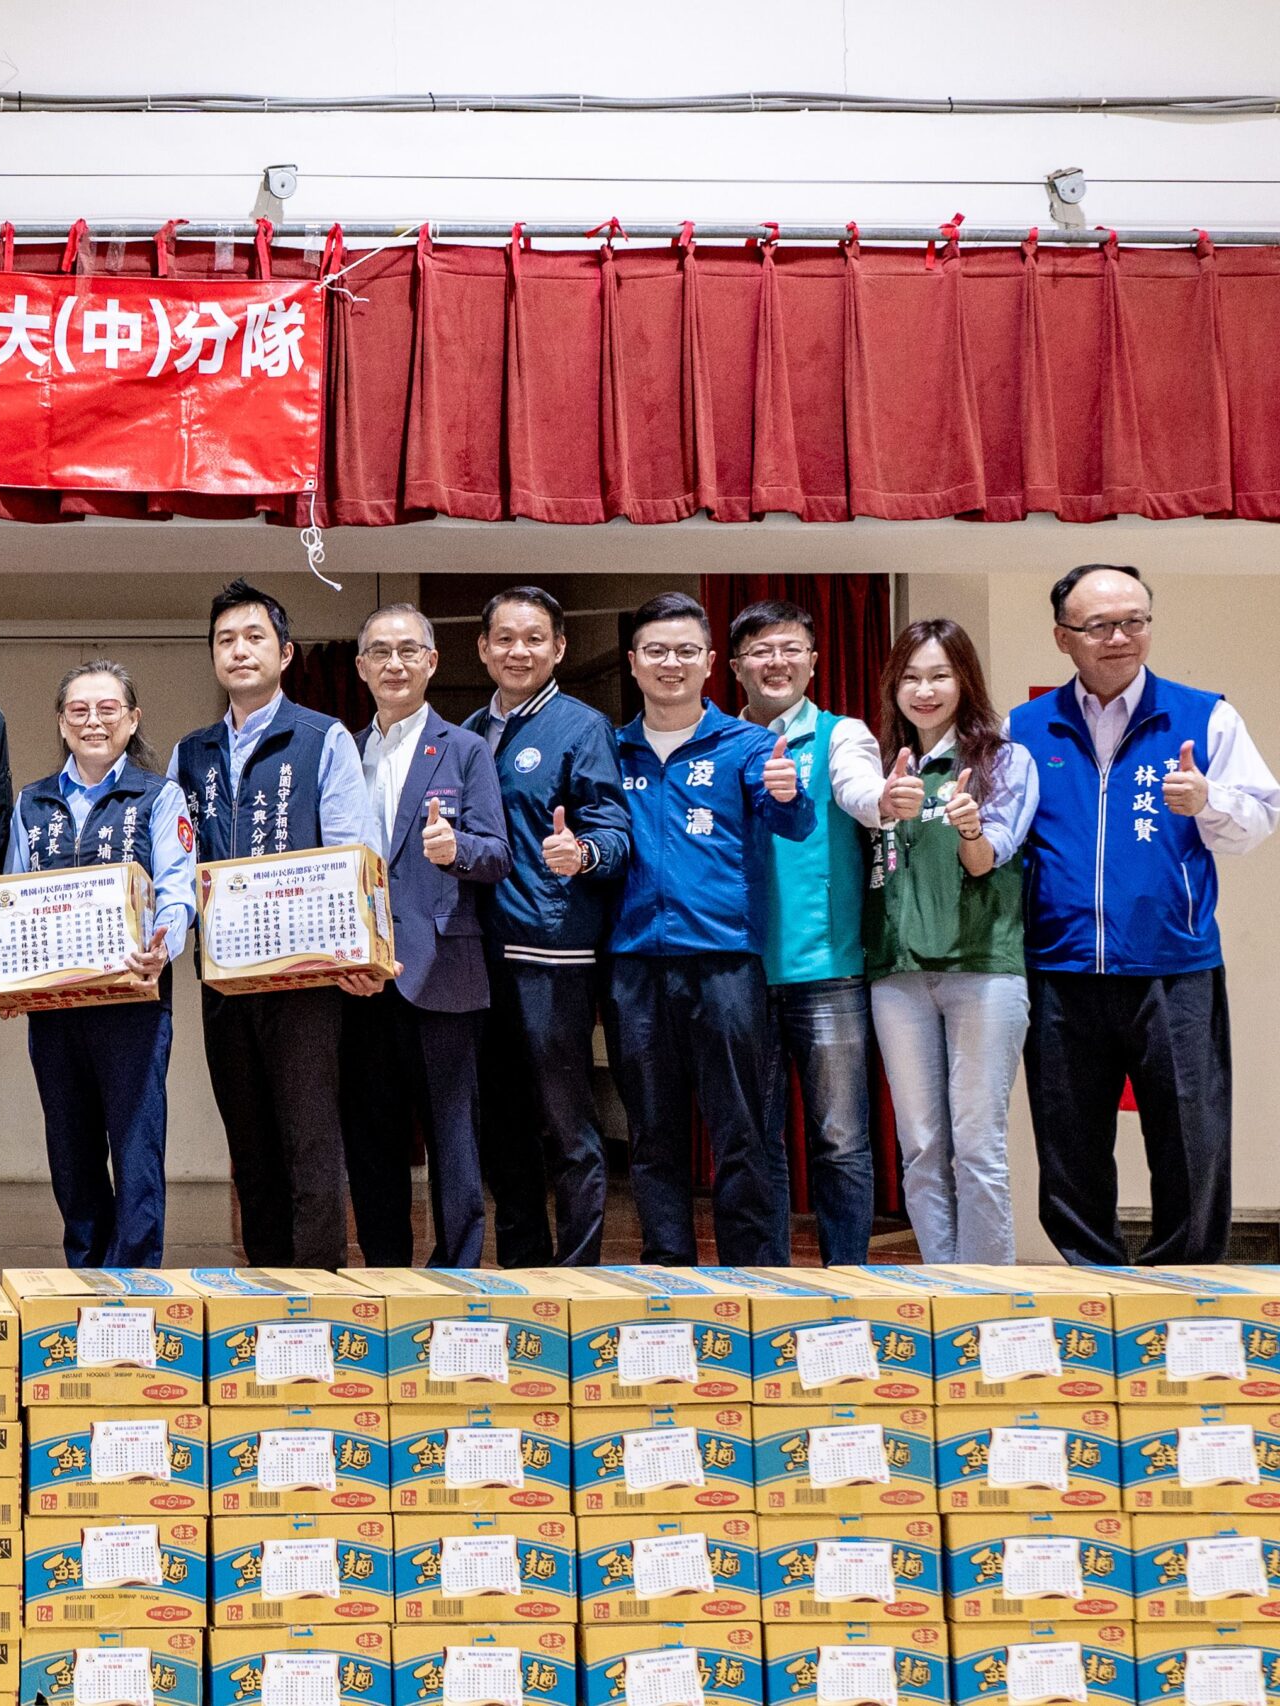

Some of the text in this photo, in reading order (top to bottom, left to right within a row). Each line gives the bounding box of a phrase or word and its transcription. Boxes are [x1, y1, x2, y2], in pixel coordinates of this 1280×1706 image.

[203, 766, 220, 820] 分隊長
[275, 762, 293, 854] 桃園守望相助中
[622, 776, 648, 791] ao
[1132, 764, 1161, 842] 林政賢
[46, 809, 69, 857] 分隊長
[97, 825, 114, 861] 新埔
